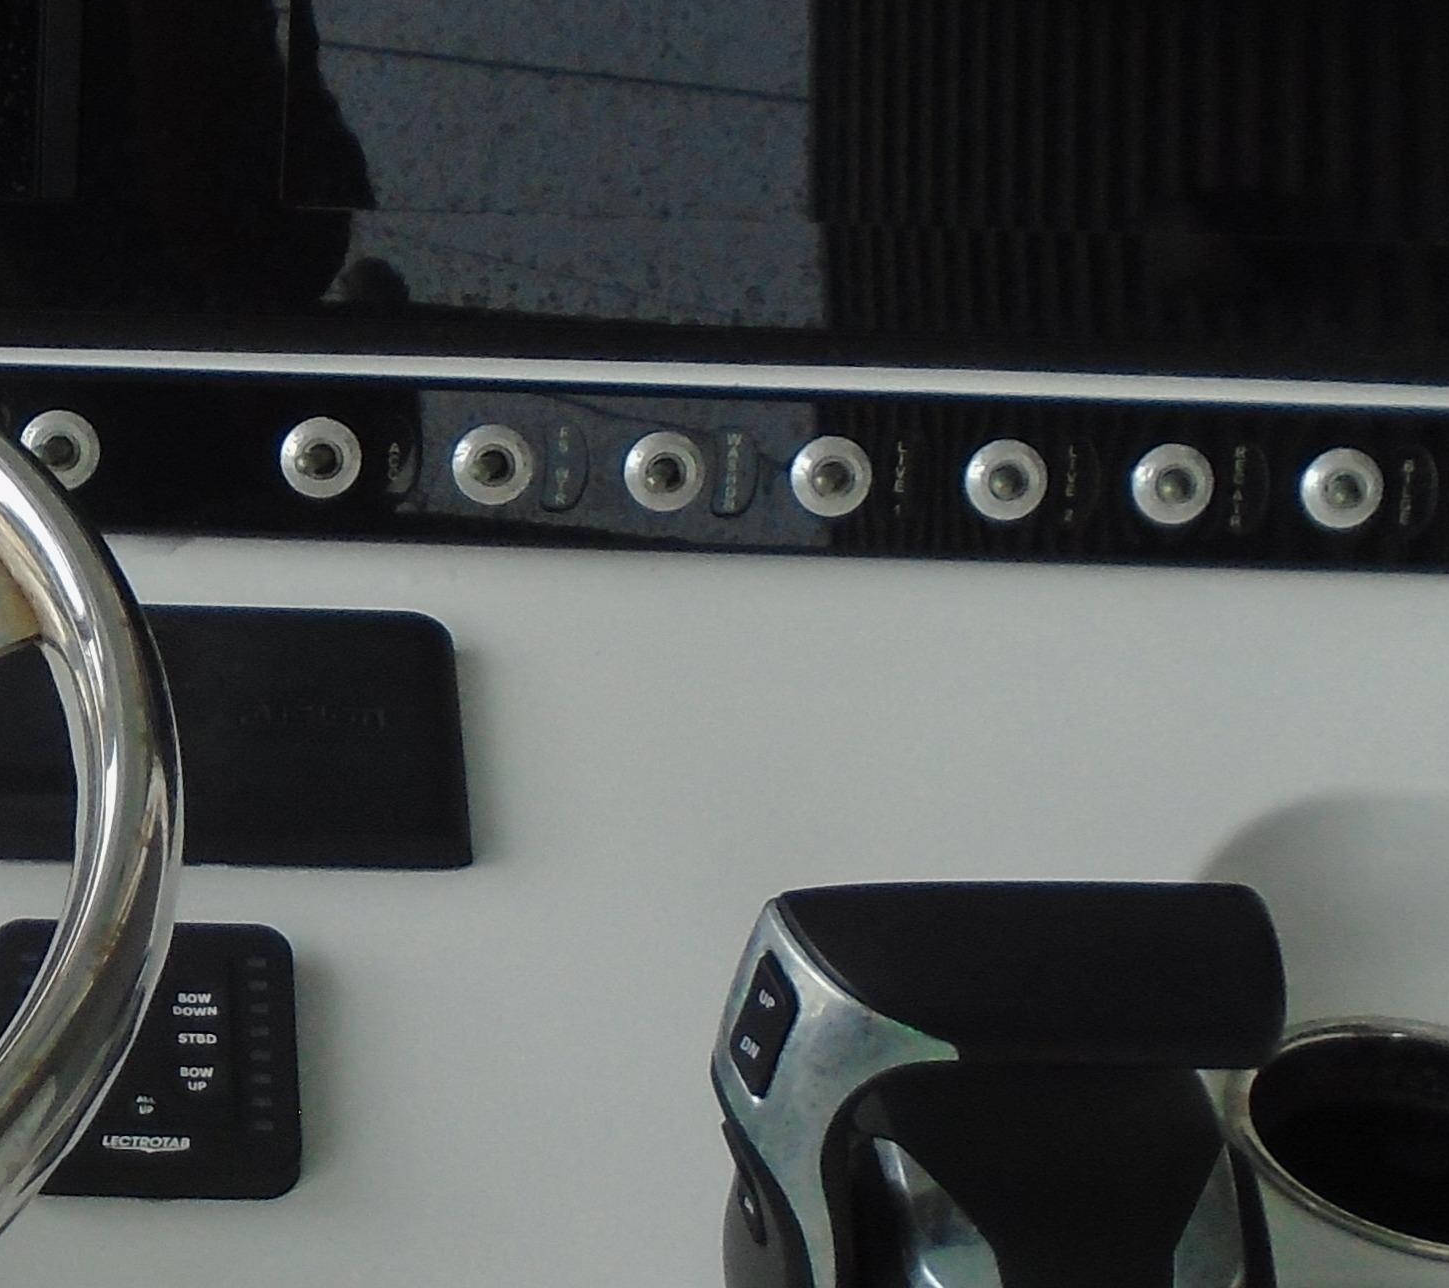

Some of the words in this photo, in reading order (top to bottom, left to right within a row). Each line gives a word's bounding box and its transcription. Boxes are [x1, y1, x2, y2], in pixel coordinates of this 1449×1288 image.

[177, 993, 212, 1004] BOW
[758, 988, 776, 1009] UP
[172, 1005, 218, 1017] DOWN
[177, 1033, 218, 1045] STBD
[740, 1034, 761, 1059] DN
[179, 1067, 214, 1078] BOW
[188, 1082, 207, 1092] UP
[139, 1106, 154, 1115] UP
[102, 1134, 190, 1152] LECTROTAB
